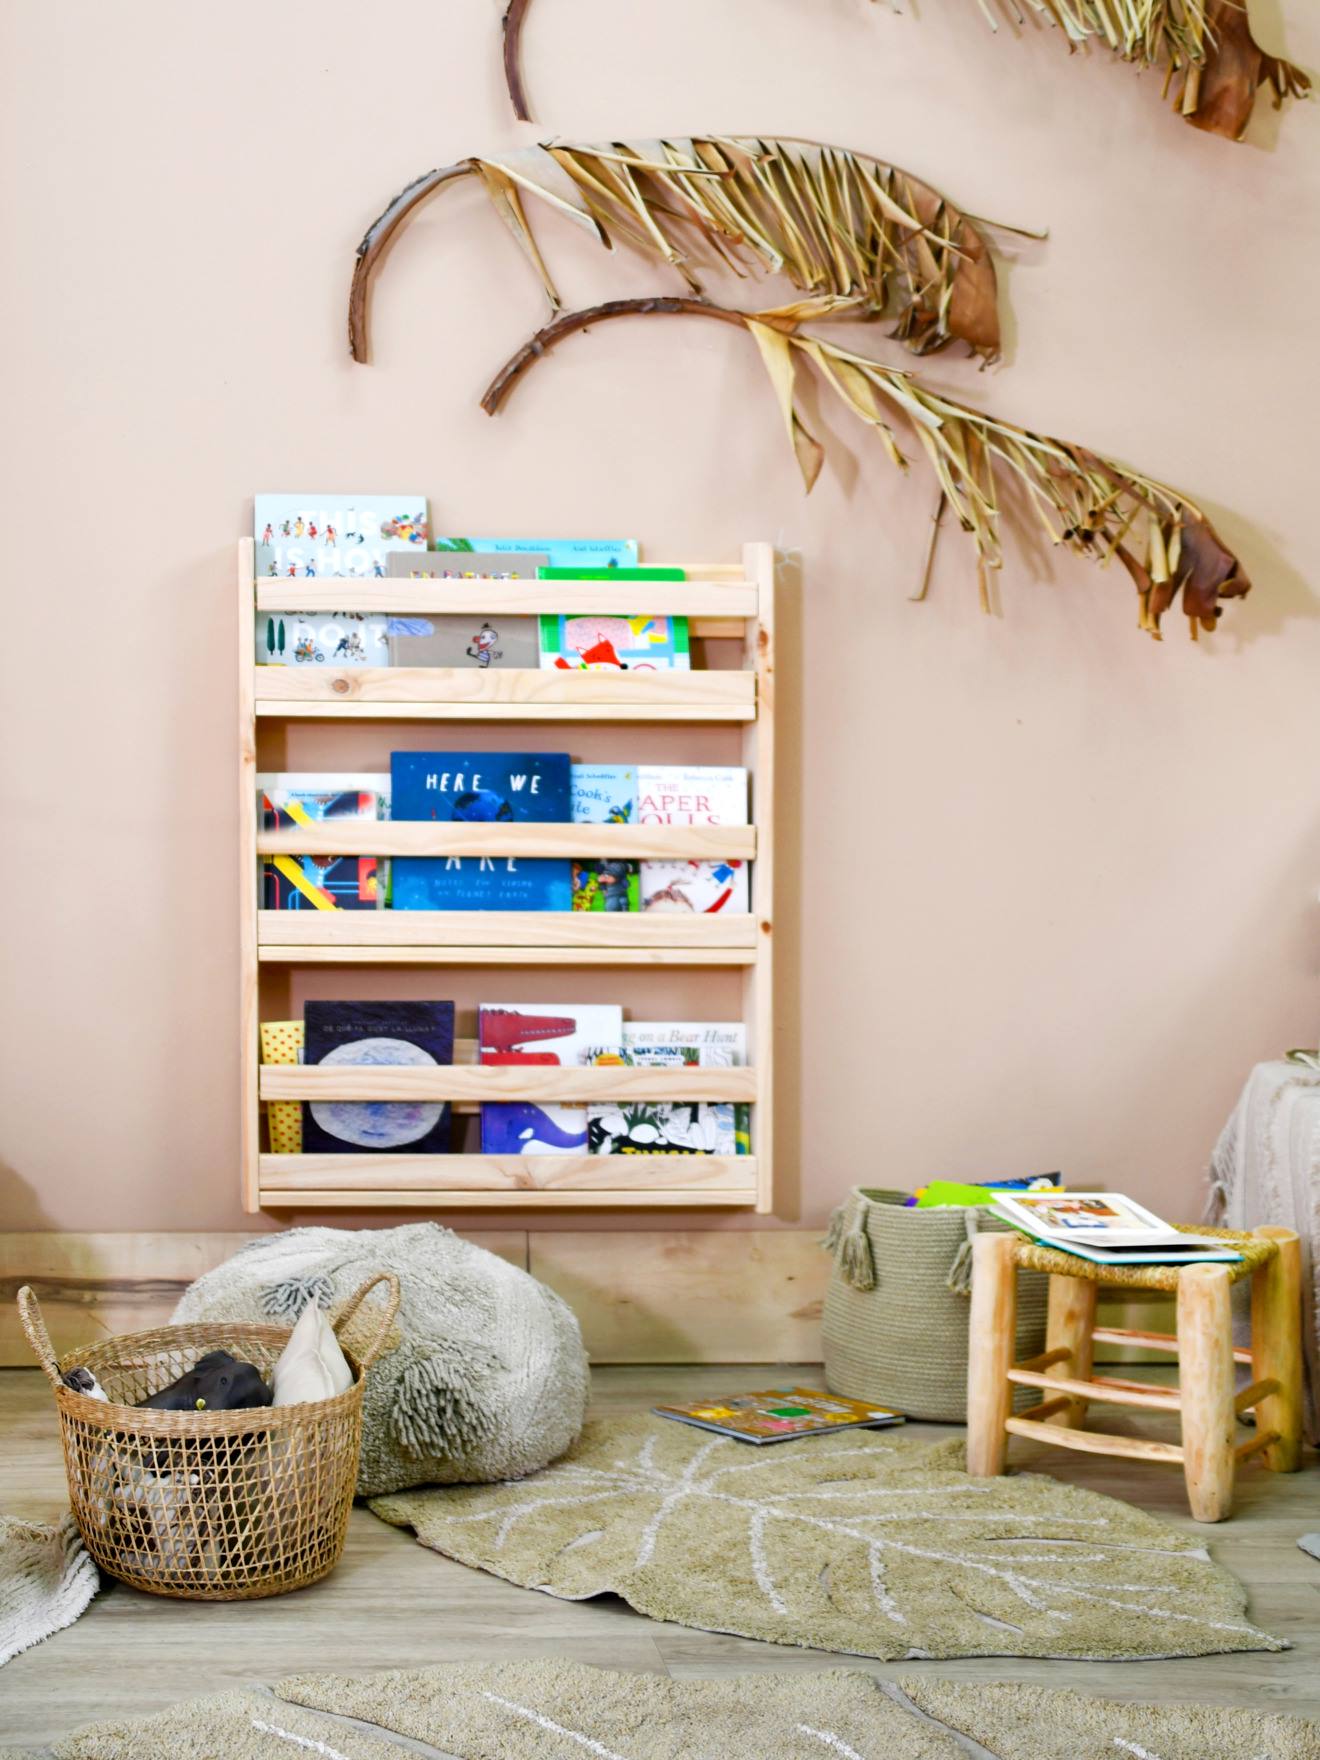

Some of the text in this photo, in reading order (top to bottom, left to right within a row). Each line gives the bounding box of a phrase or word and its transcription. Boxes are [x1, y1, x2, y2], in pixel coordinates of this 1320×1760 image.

[292, 622, 345, 648] DO
[426, 773, 541, 794] HERE WE
[655, 784, 680, 792] THE
[638, 795, 712, 812] APER
[669, 1030, 700, 1042] Bear
[703, 1030, 738, 1043] Hunt
